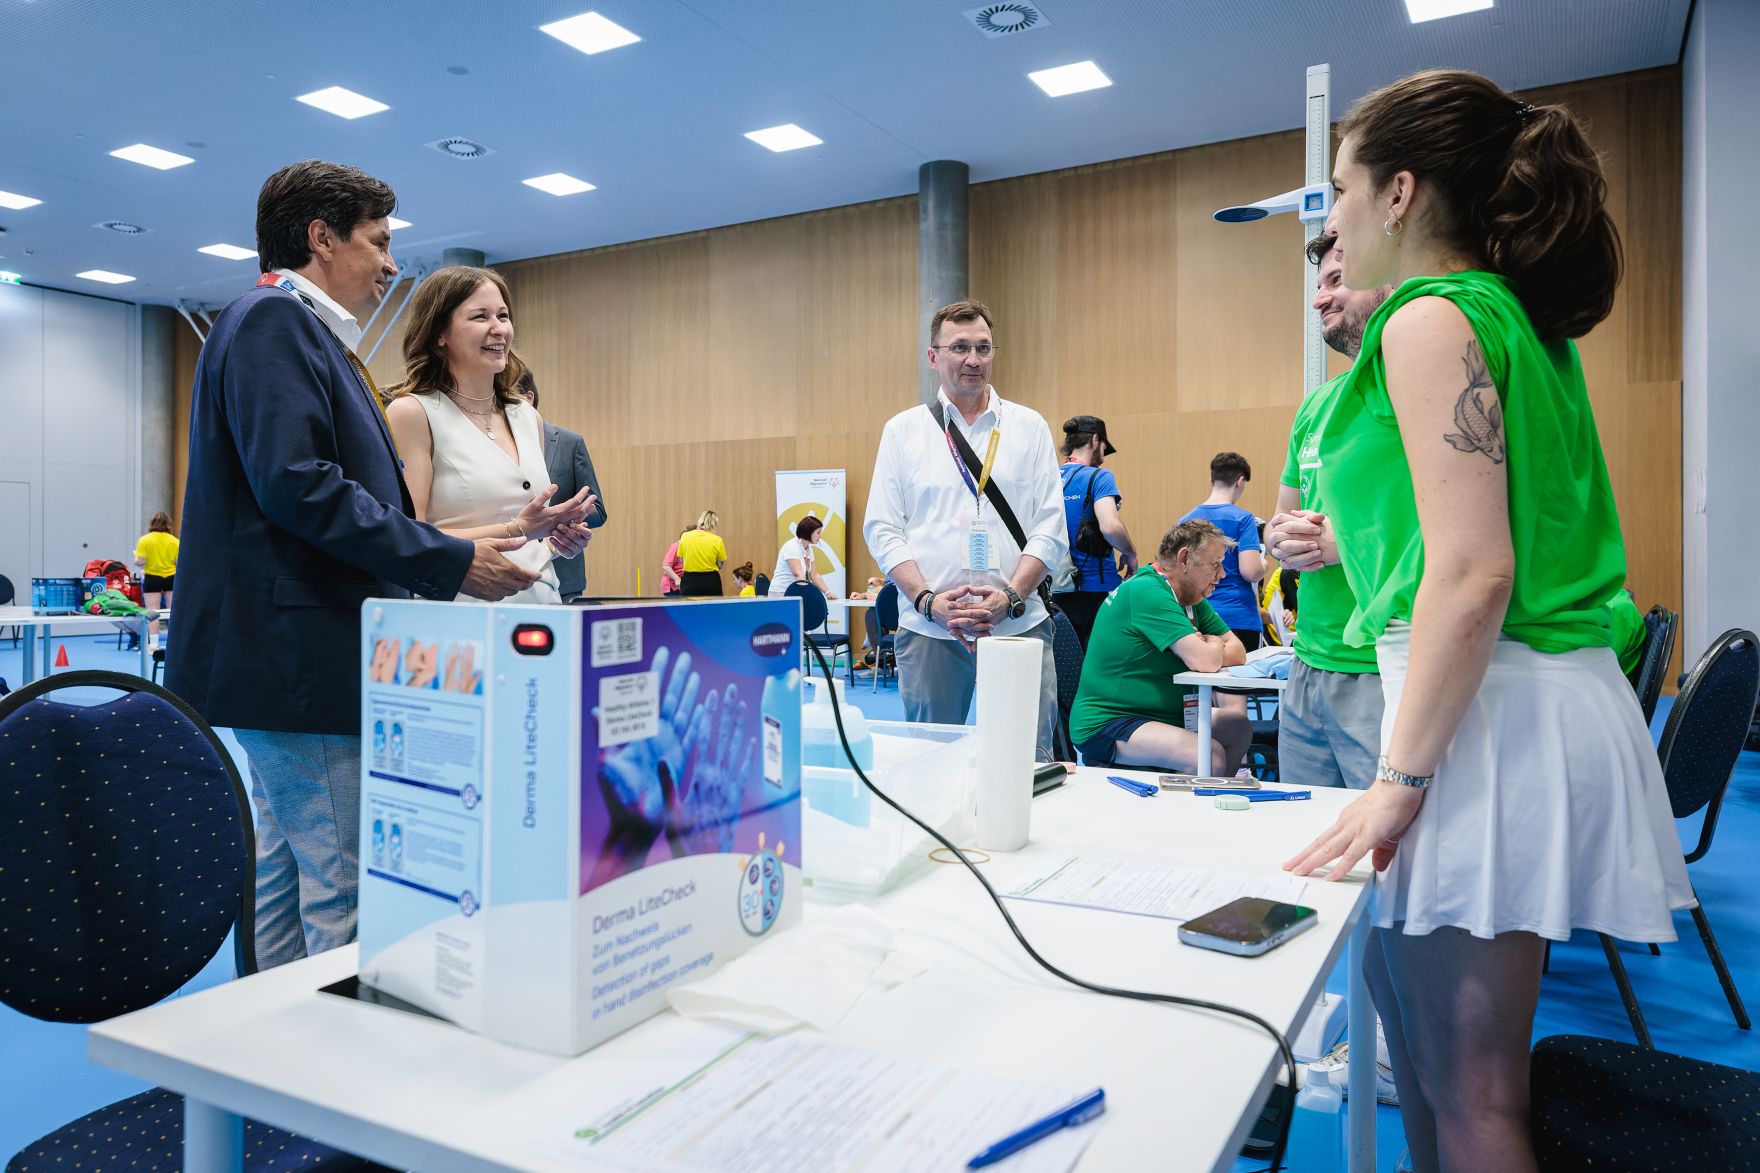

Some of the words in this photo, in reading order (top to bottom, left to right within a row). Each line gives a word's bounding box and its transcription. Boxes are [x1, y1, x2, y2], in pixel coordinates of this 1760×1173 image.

[524, 677, 539, 767] LiteCheck
[522, 771, 537, 829] Derma
[592, 905, 635, 936] Derma
[638, 879, 697, 917] LiteCheck
[592, 942, 614, 959] Zum
[616, 920, 660, 946] Nachweis
[592, 960, 610, 976] von
[592, 970, 638, 1000] Detection
[639, 961, 649, 978] of
[603, 993, 627, 1013] hand
